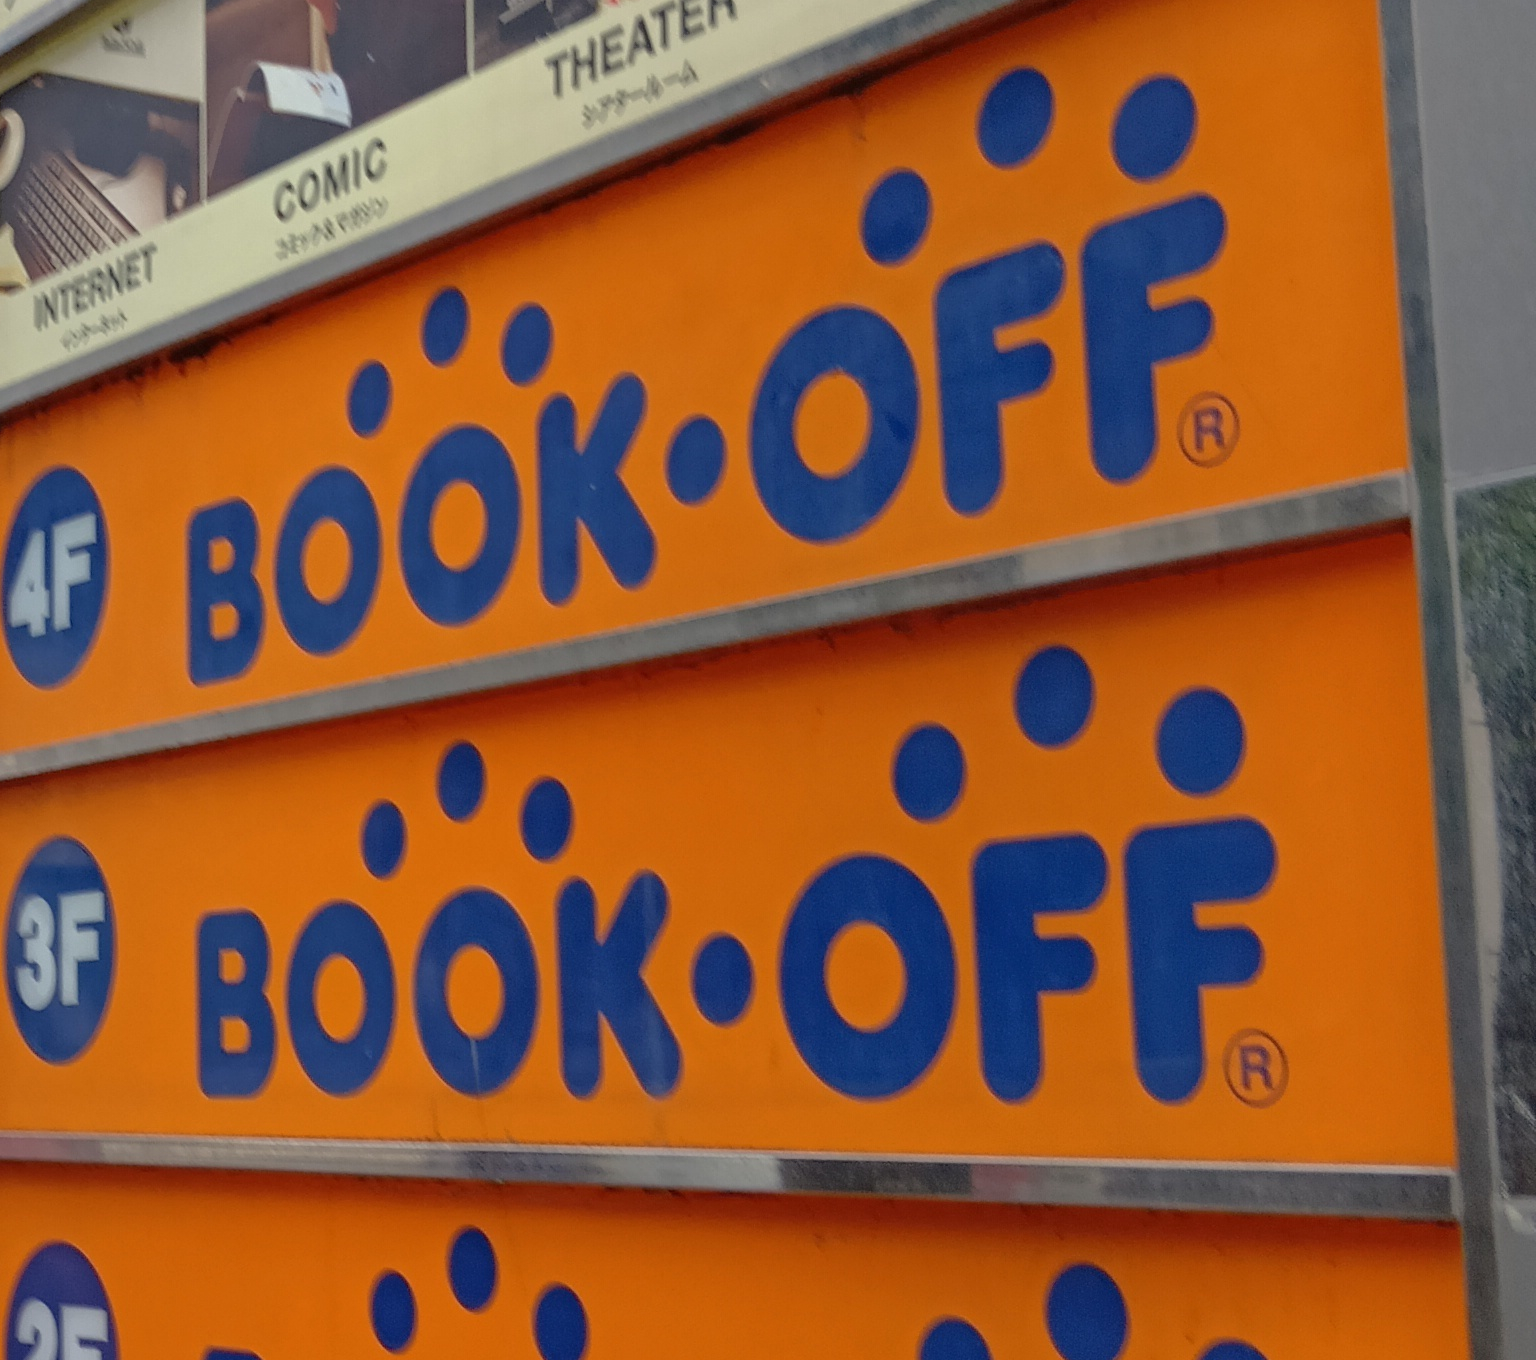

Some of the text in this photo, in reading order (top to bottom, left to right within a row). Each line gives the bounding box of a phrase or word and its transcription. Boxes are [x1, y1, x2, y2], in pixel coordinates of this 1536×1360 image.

[273, 136, 388, 225] COMIC
[33, 241, 158, 333] INTERNET
[8, 512, 99, 638] 4F
[16, 891, 107, 1013] 3F
